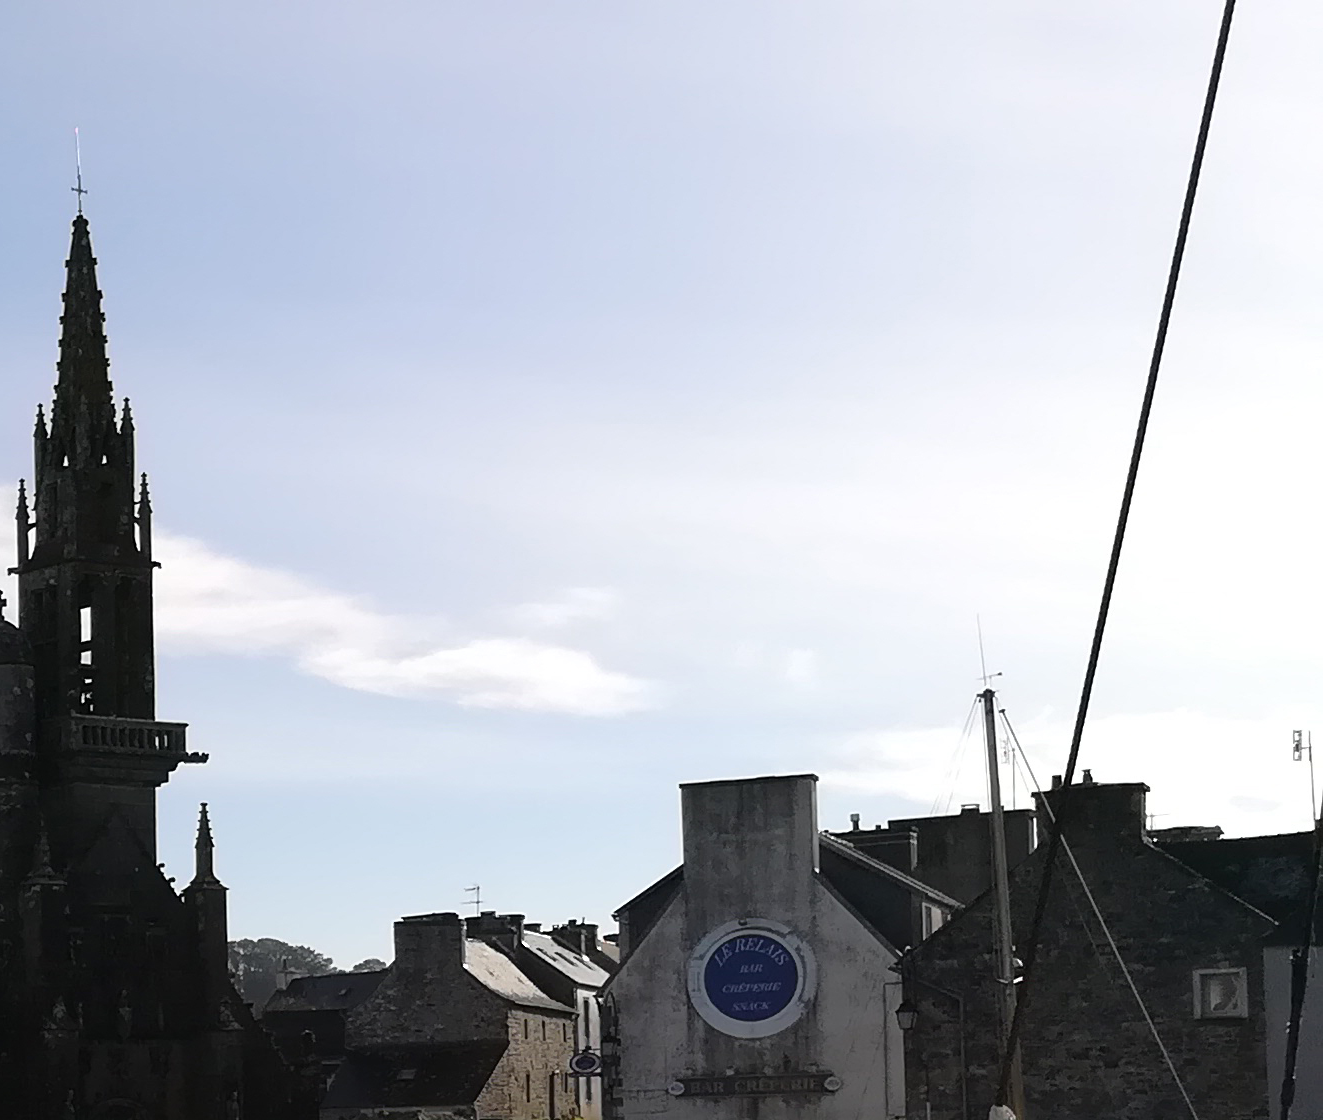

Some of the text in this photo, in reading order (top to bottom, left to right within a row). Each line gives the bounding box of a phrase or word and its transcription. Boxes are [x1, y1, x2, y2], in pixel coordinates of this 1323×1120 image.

[714, 937, 790, 968] LE RELAIS
[739, 963, 764, 974] BAR
[732, 1001, 771, 1011] SNACK
[691, 1081, 724, 1093] BAR
